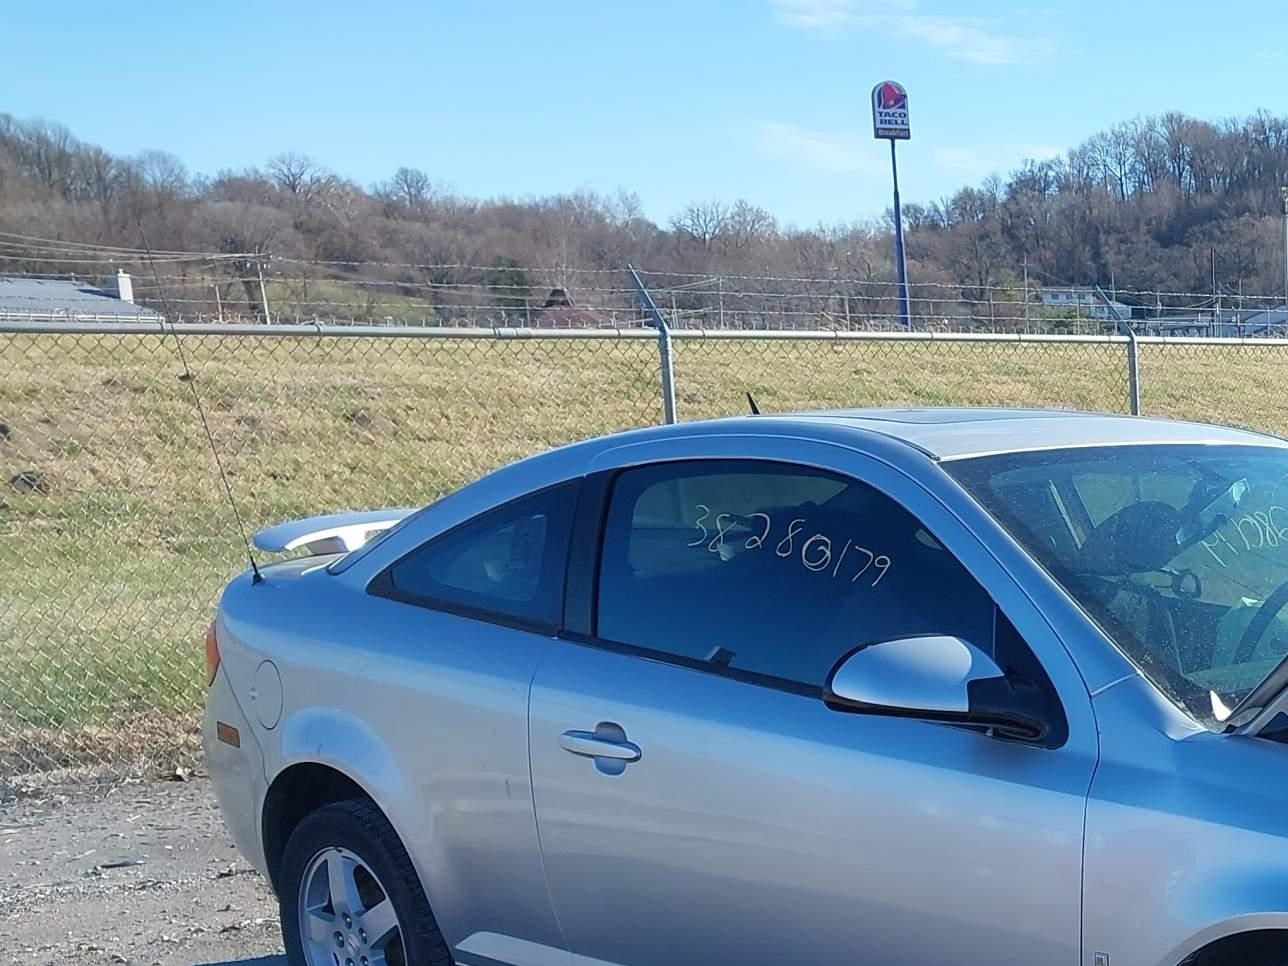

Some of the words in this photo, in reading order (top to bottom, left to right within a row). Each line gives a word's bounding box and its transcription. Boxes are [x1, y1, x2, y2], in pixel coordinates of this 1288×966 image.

[878, 111, 907, 119] TACO
[879, 118, 908, 126] BELL
[687, 504, 892, 587] 38280179
